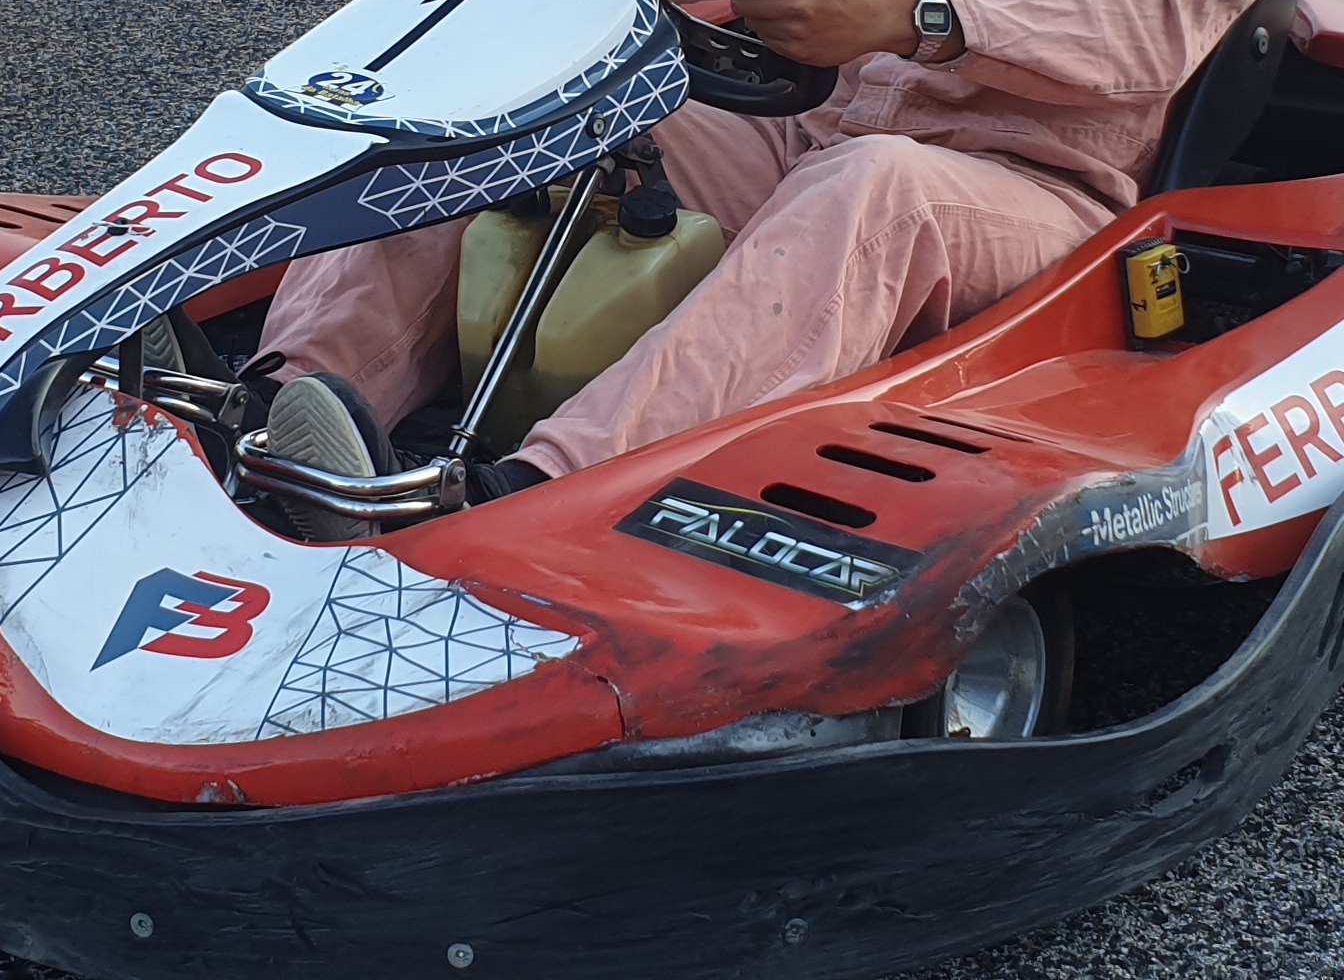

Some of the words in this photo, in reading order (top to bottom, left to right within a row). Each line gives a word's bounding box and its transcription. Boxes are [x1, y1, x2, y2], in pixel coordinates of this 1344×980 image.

[315, 72, 376, 96] 24
[650, 496, 896, 592] PALOCAR
[1090, 492, 1165, 547] Metallic
